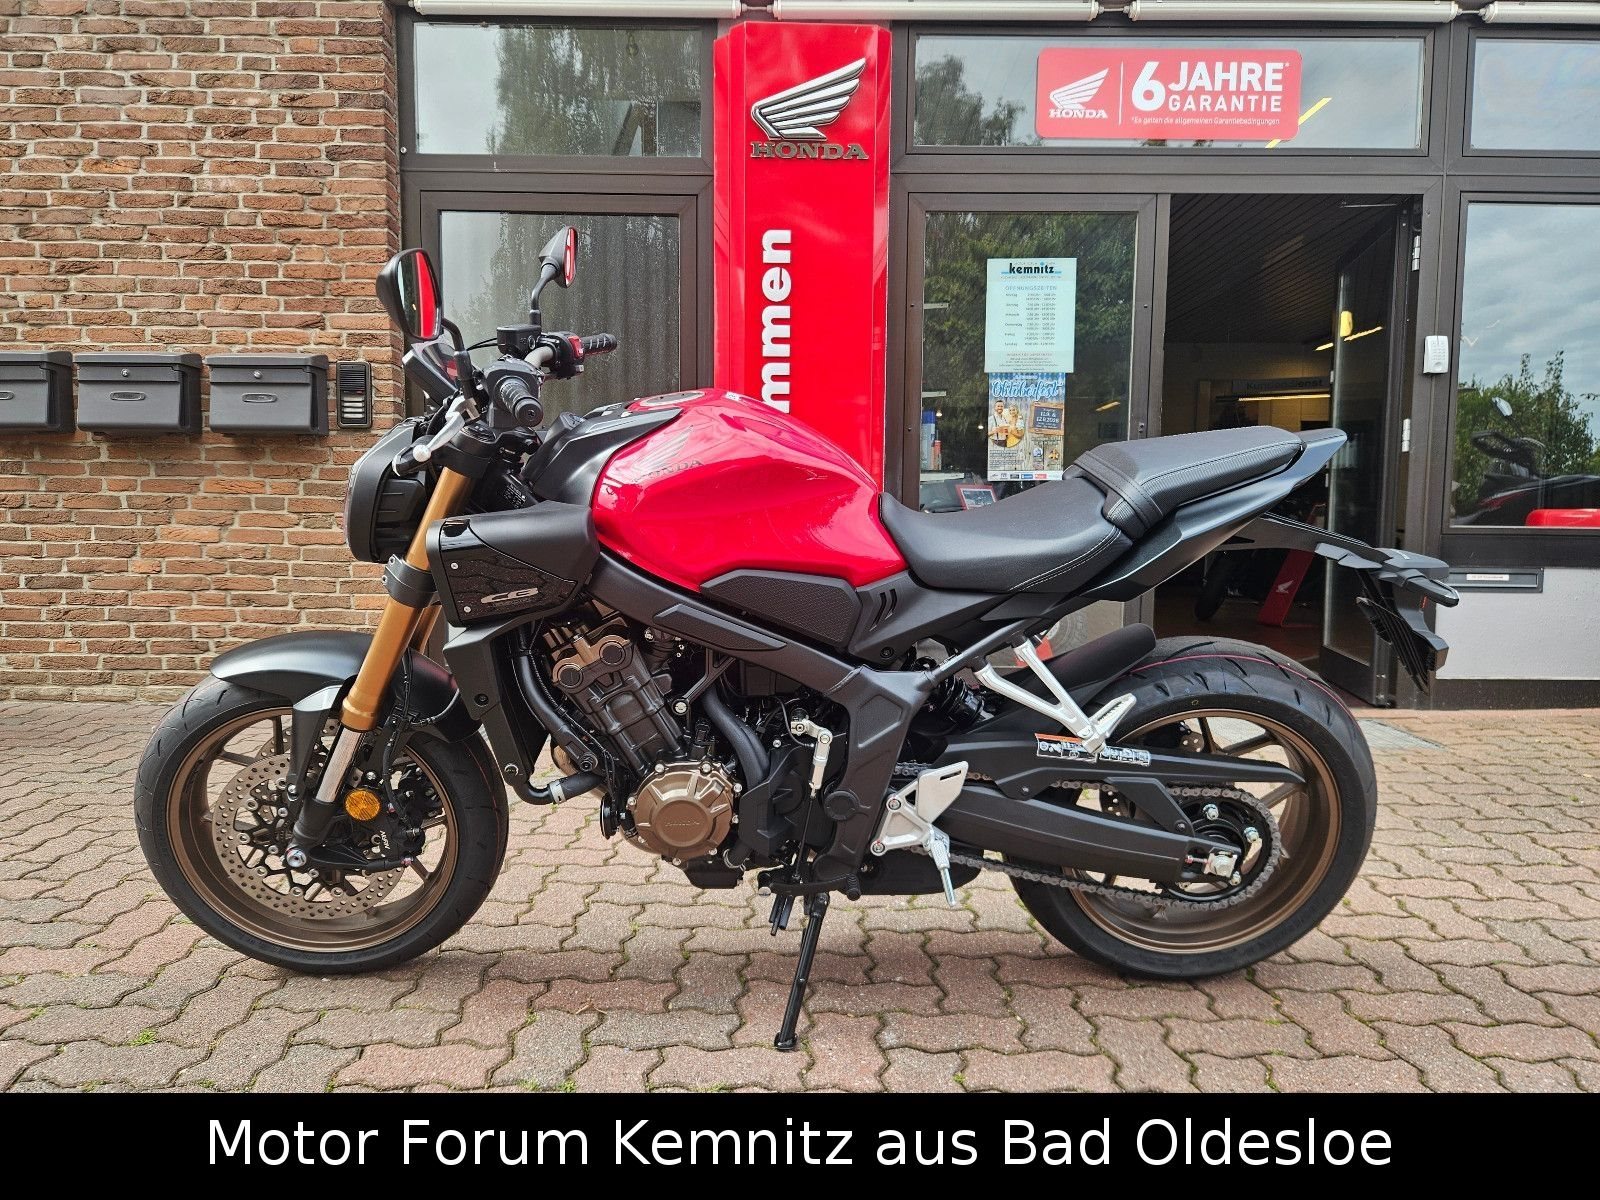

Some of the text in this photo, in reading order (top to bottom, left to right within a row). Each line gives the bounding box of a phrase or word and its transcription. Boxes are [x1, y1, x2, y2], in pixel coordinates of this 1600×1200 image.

[1131, 61, 1166, 112] 6
[1168, 94, 1282, 112] GARANTIE
[1048, 108, 1109, 119] HONDA
[1214, 117, 1280, 126] Garantiebedingungen
[750, 141, 869, 160] HONDA
[1009, 262, 1055, 275] kemnitz
[992, 379, 1064, 401] Oktoberfest
